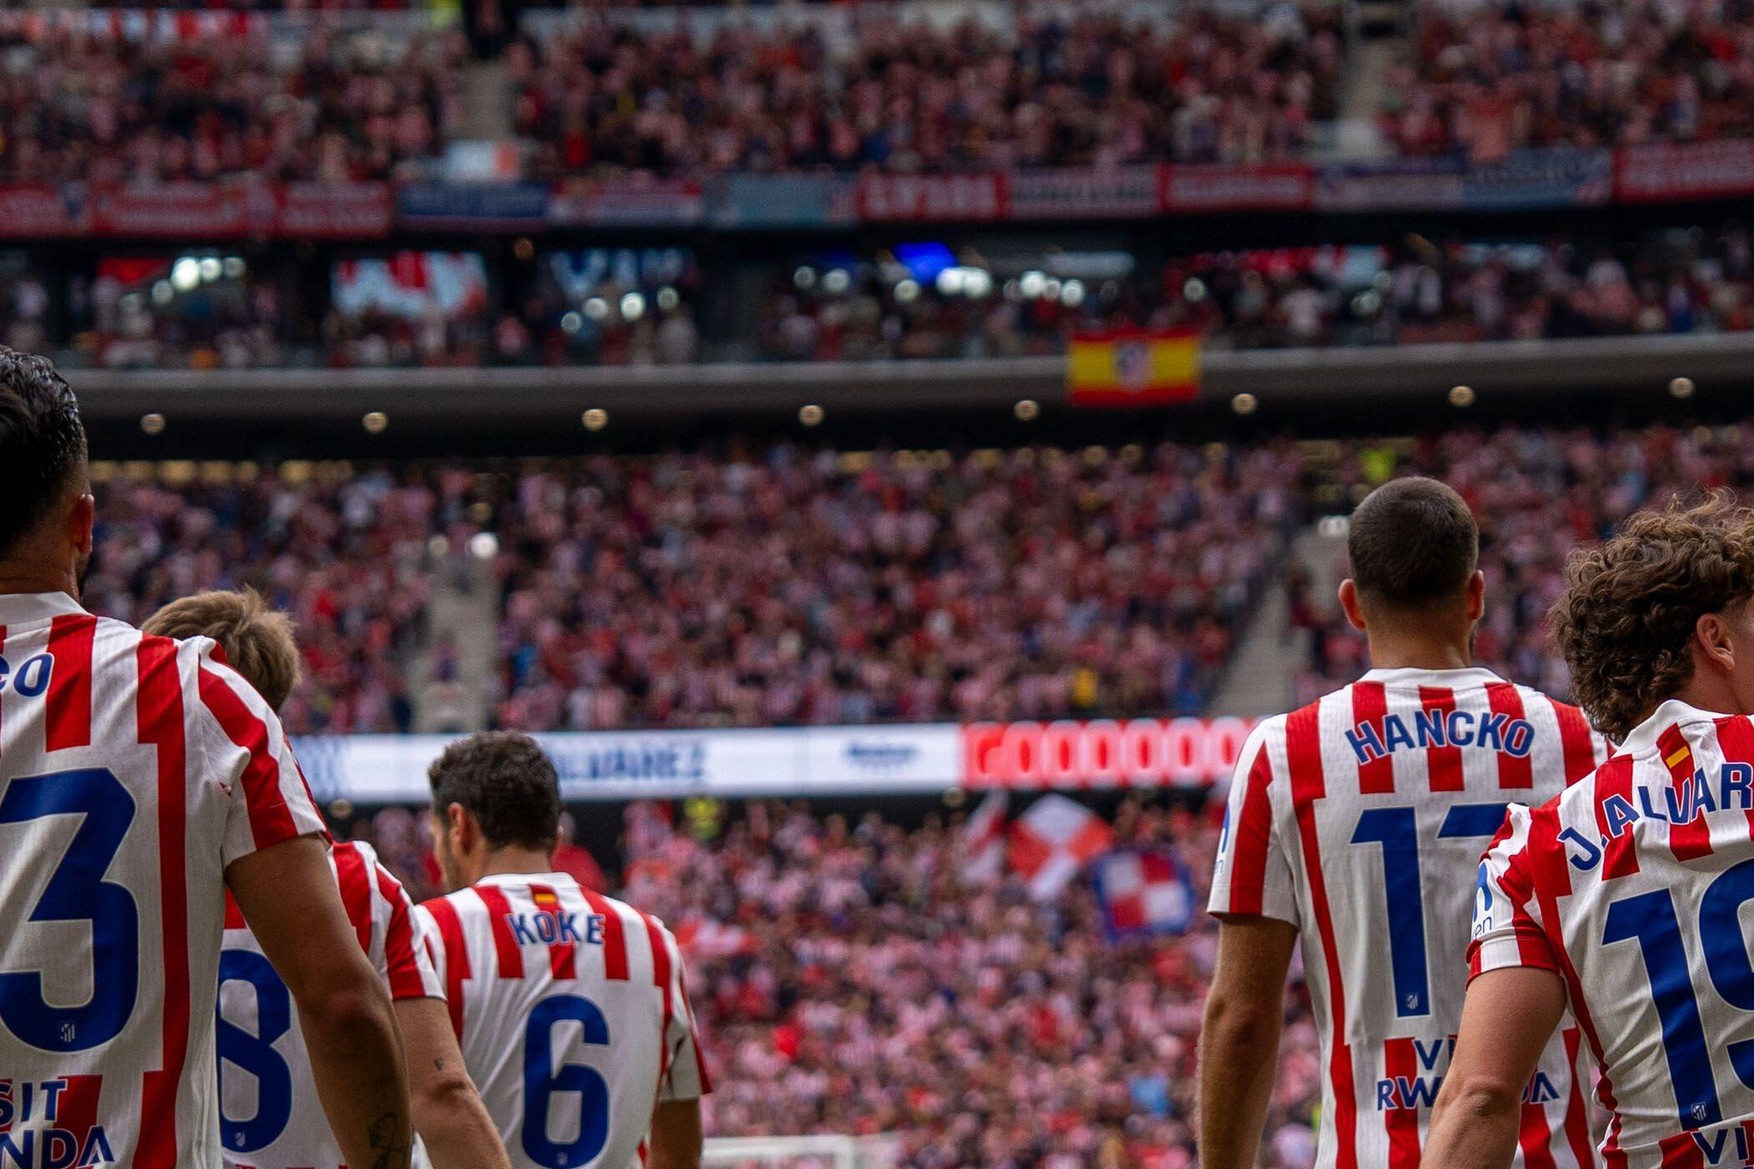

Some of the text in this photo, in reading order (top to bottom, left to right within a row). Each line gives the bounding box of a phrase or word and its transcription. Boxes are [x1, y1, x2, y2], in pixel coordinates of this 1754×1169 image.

[552, 746, 705, 780] LVAREZ
[1345, 708, 1536, 764] HANCKO
[0, 766, 139, 1052] 3
[507, 911, 606, 946] KOKE
[215, 948, 293, 1153] 8
